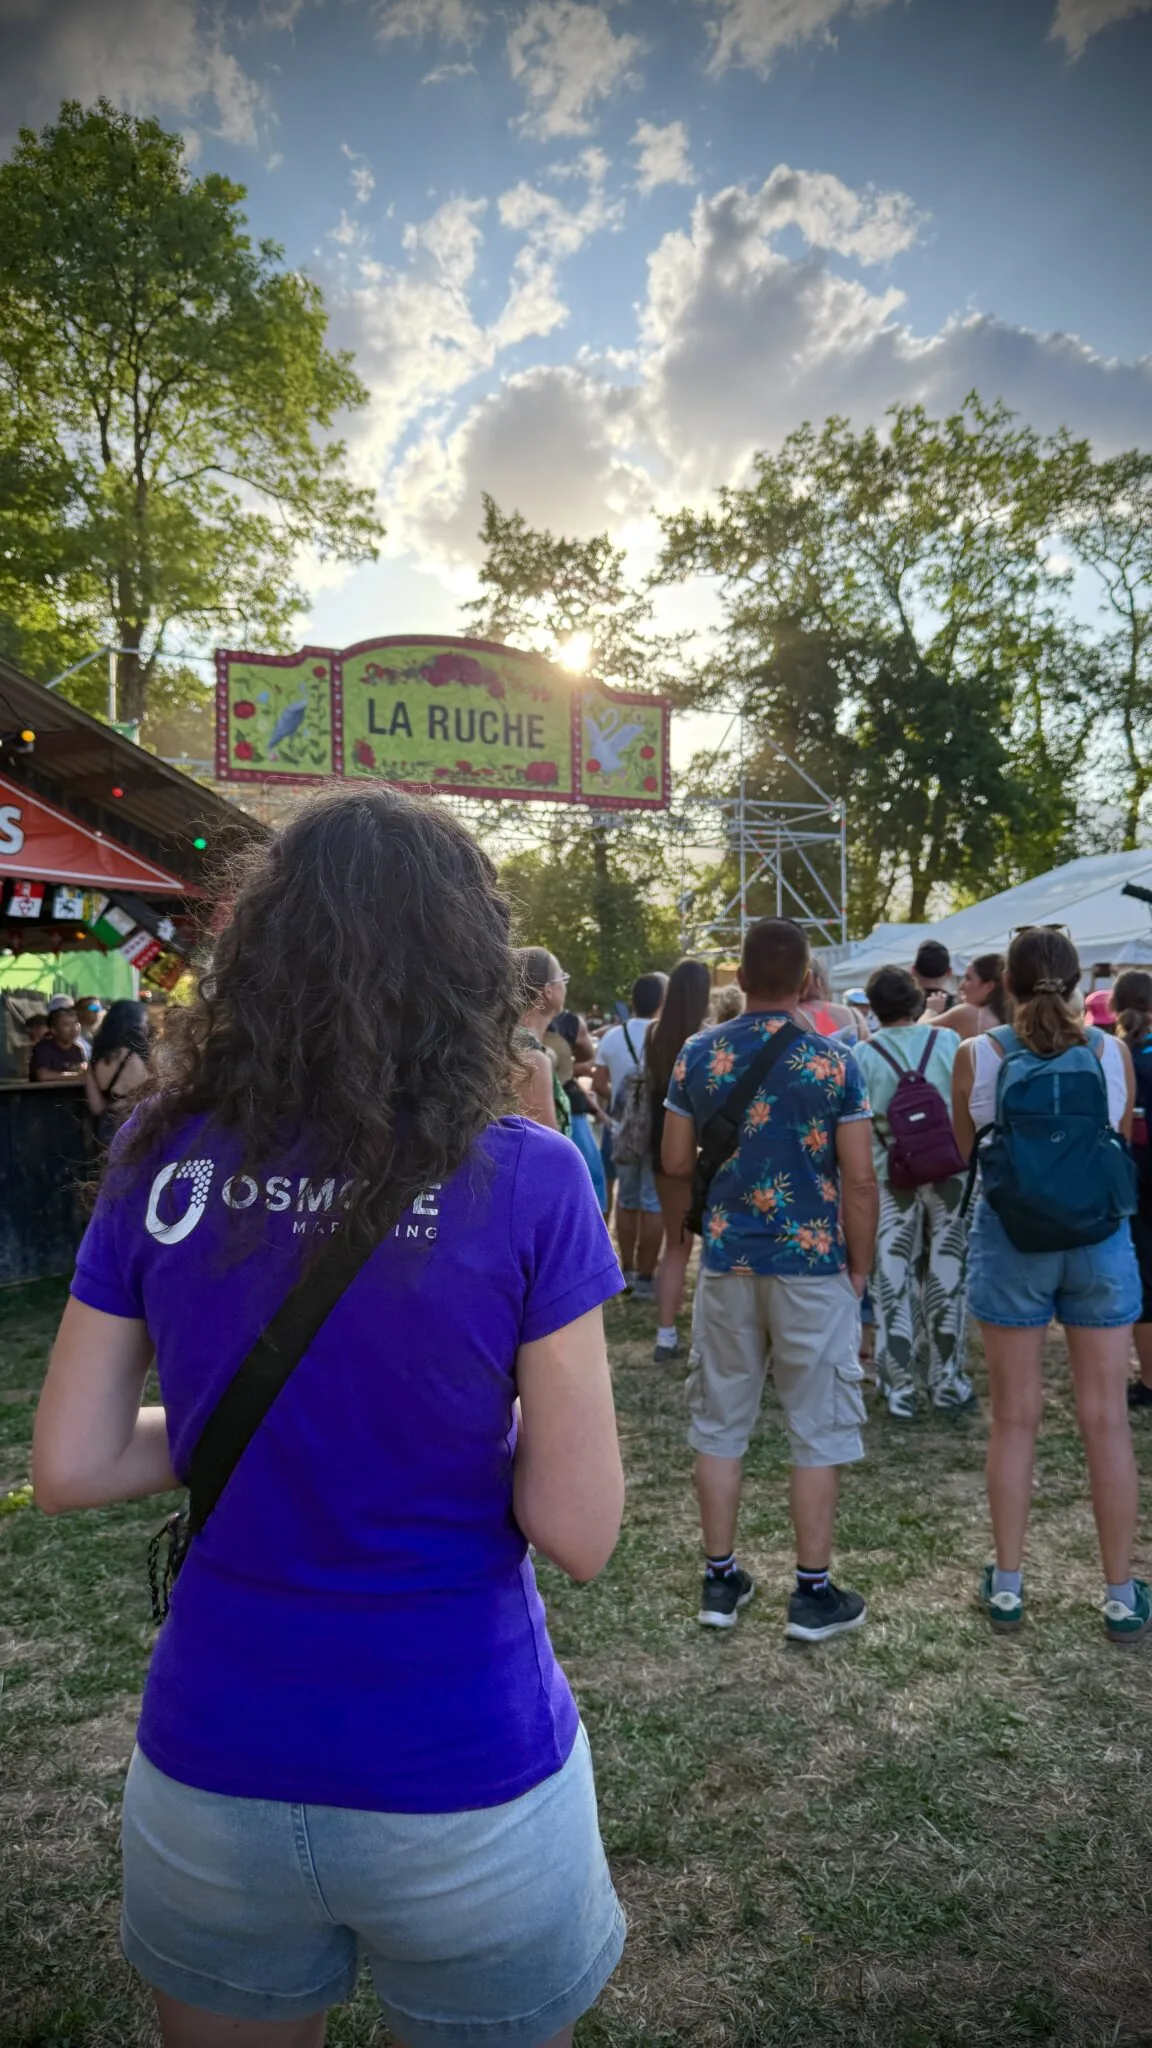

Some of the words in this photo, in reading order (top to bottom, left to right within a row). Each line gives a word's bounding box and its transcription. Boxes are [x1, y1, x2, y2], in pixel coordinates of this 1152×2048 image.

[368, 698, 413, 738] LA
[429, 704, 545, 750] RUCHE
[222, 1174, 442, 1216] OSME
[293, 1220, 438, 1240] MARING
